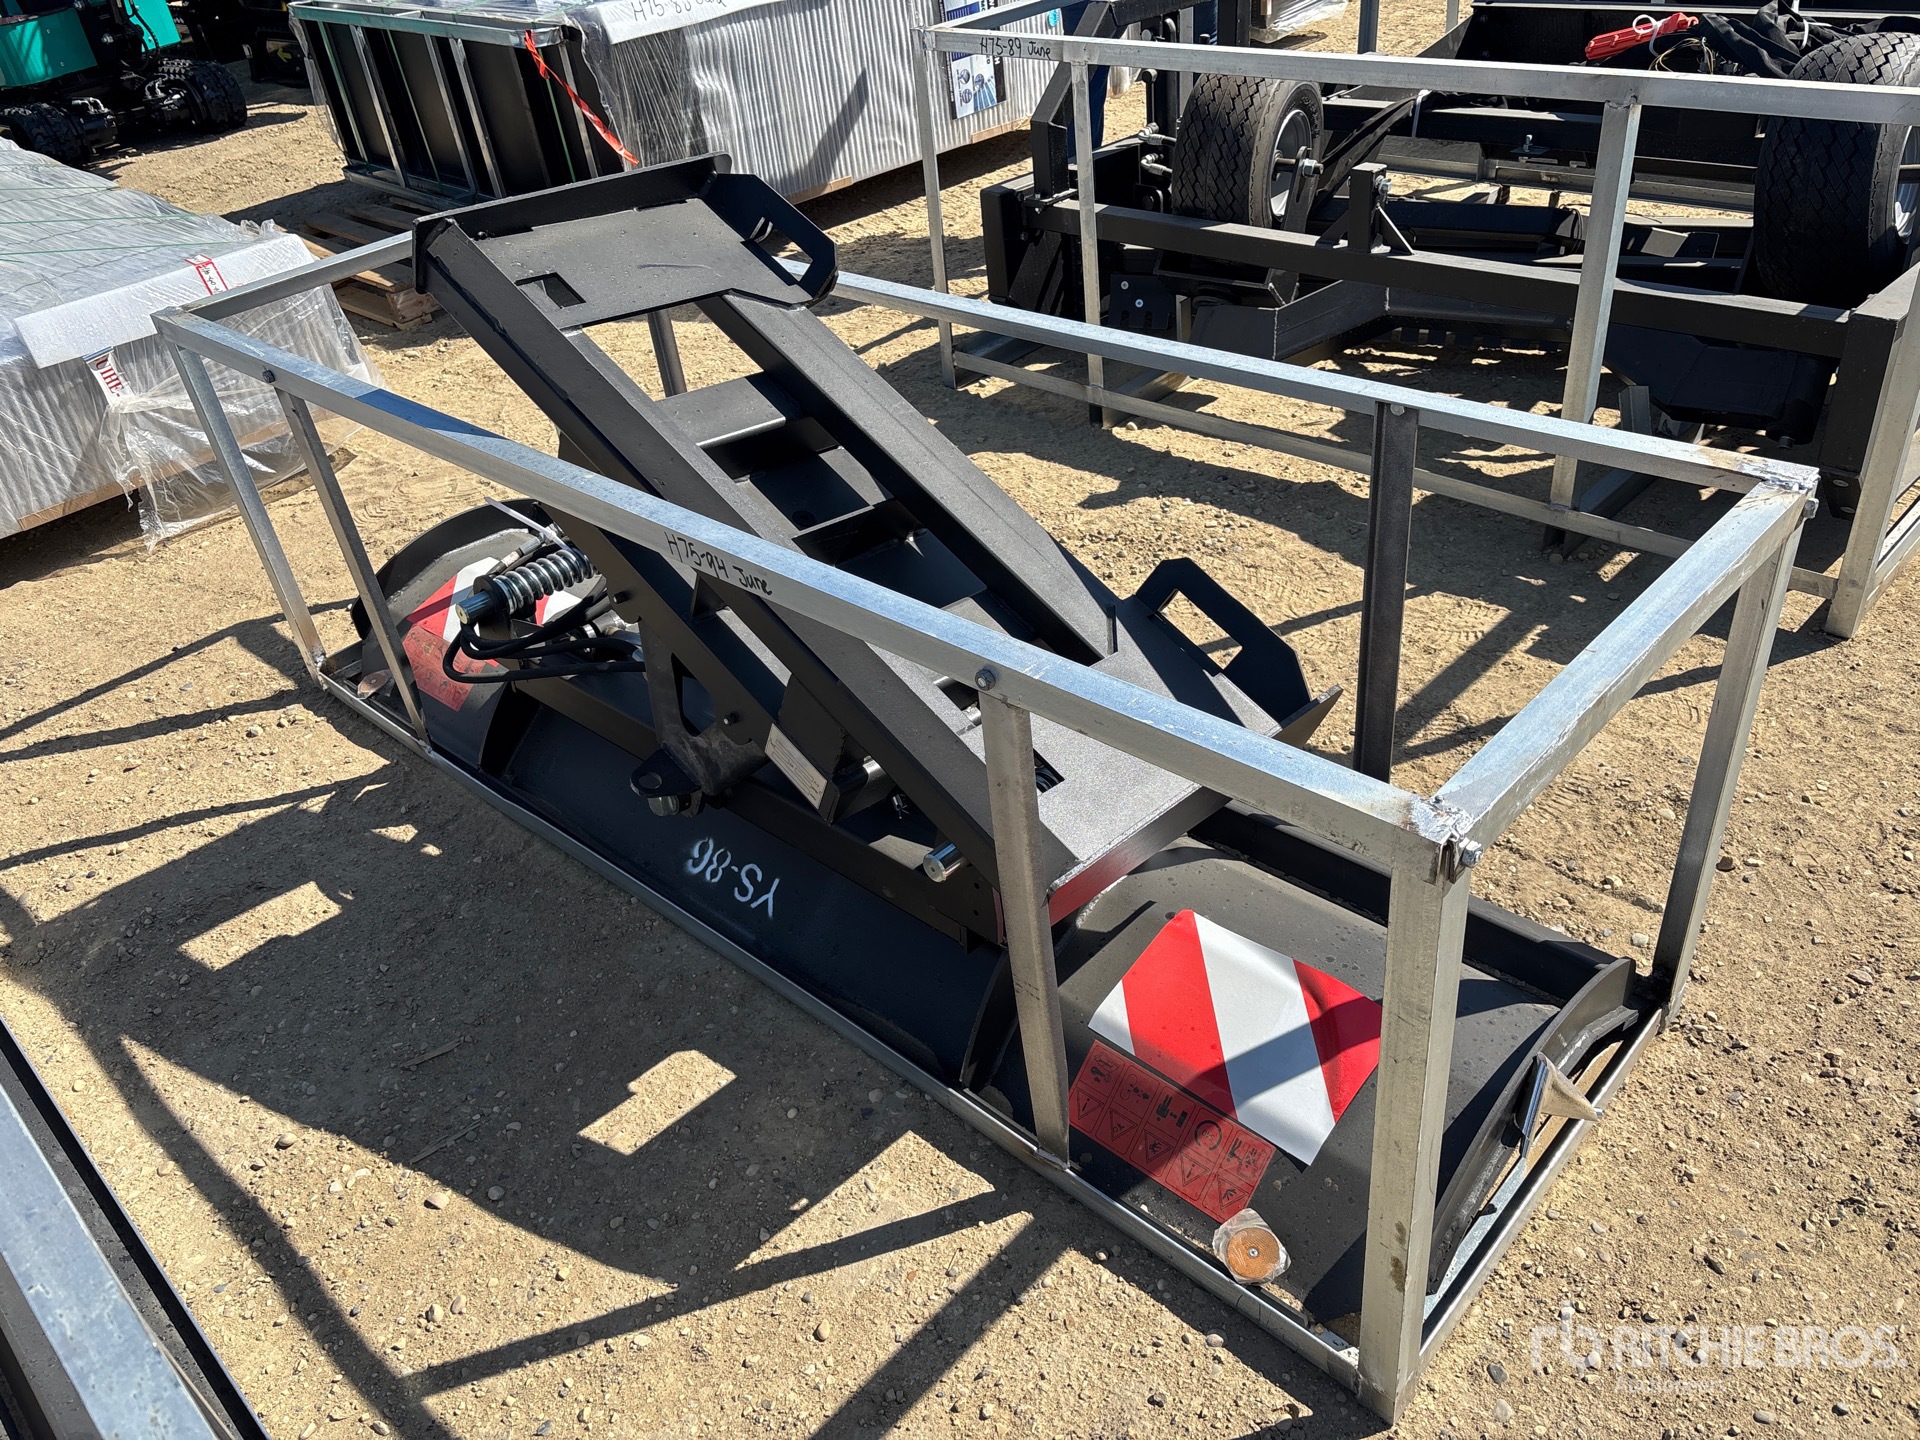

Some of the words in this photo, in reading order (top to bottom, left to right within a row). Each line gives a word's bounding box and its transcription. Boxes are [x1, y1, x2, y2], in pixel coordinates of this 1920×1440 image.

[980, 37, 1021, 58] H75-89
[1028, 41, 1052, 60] June
[664, 531, 729, 579] H75-94
[733, 565, 773, 595] June
